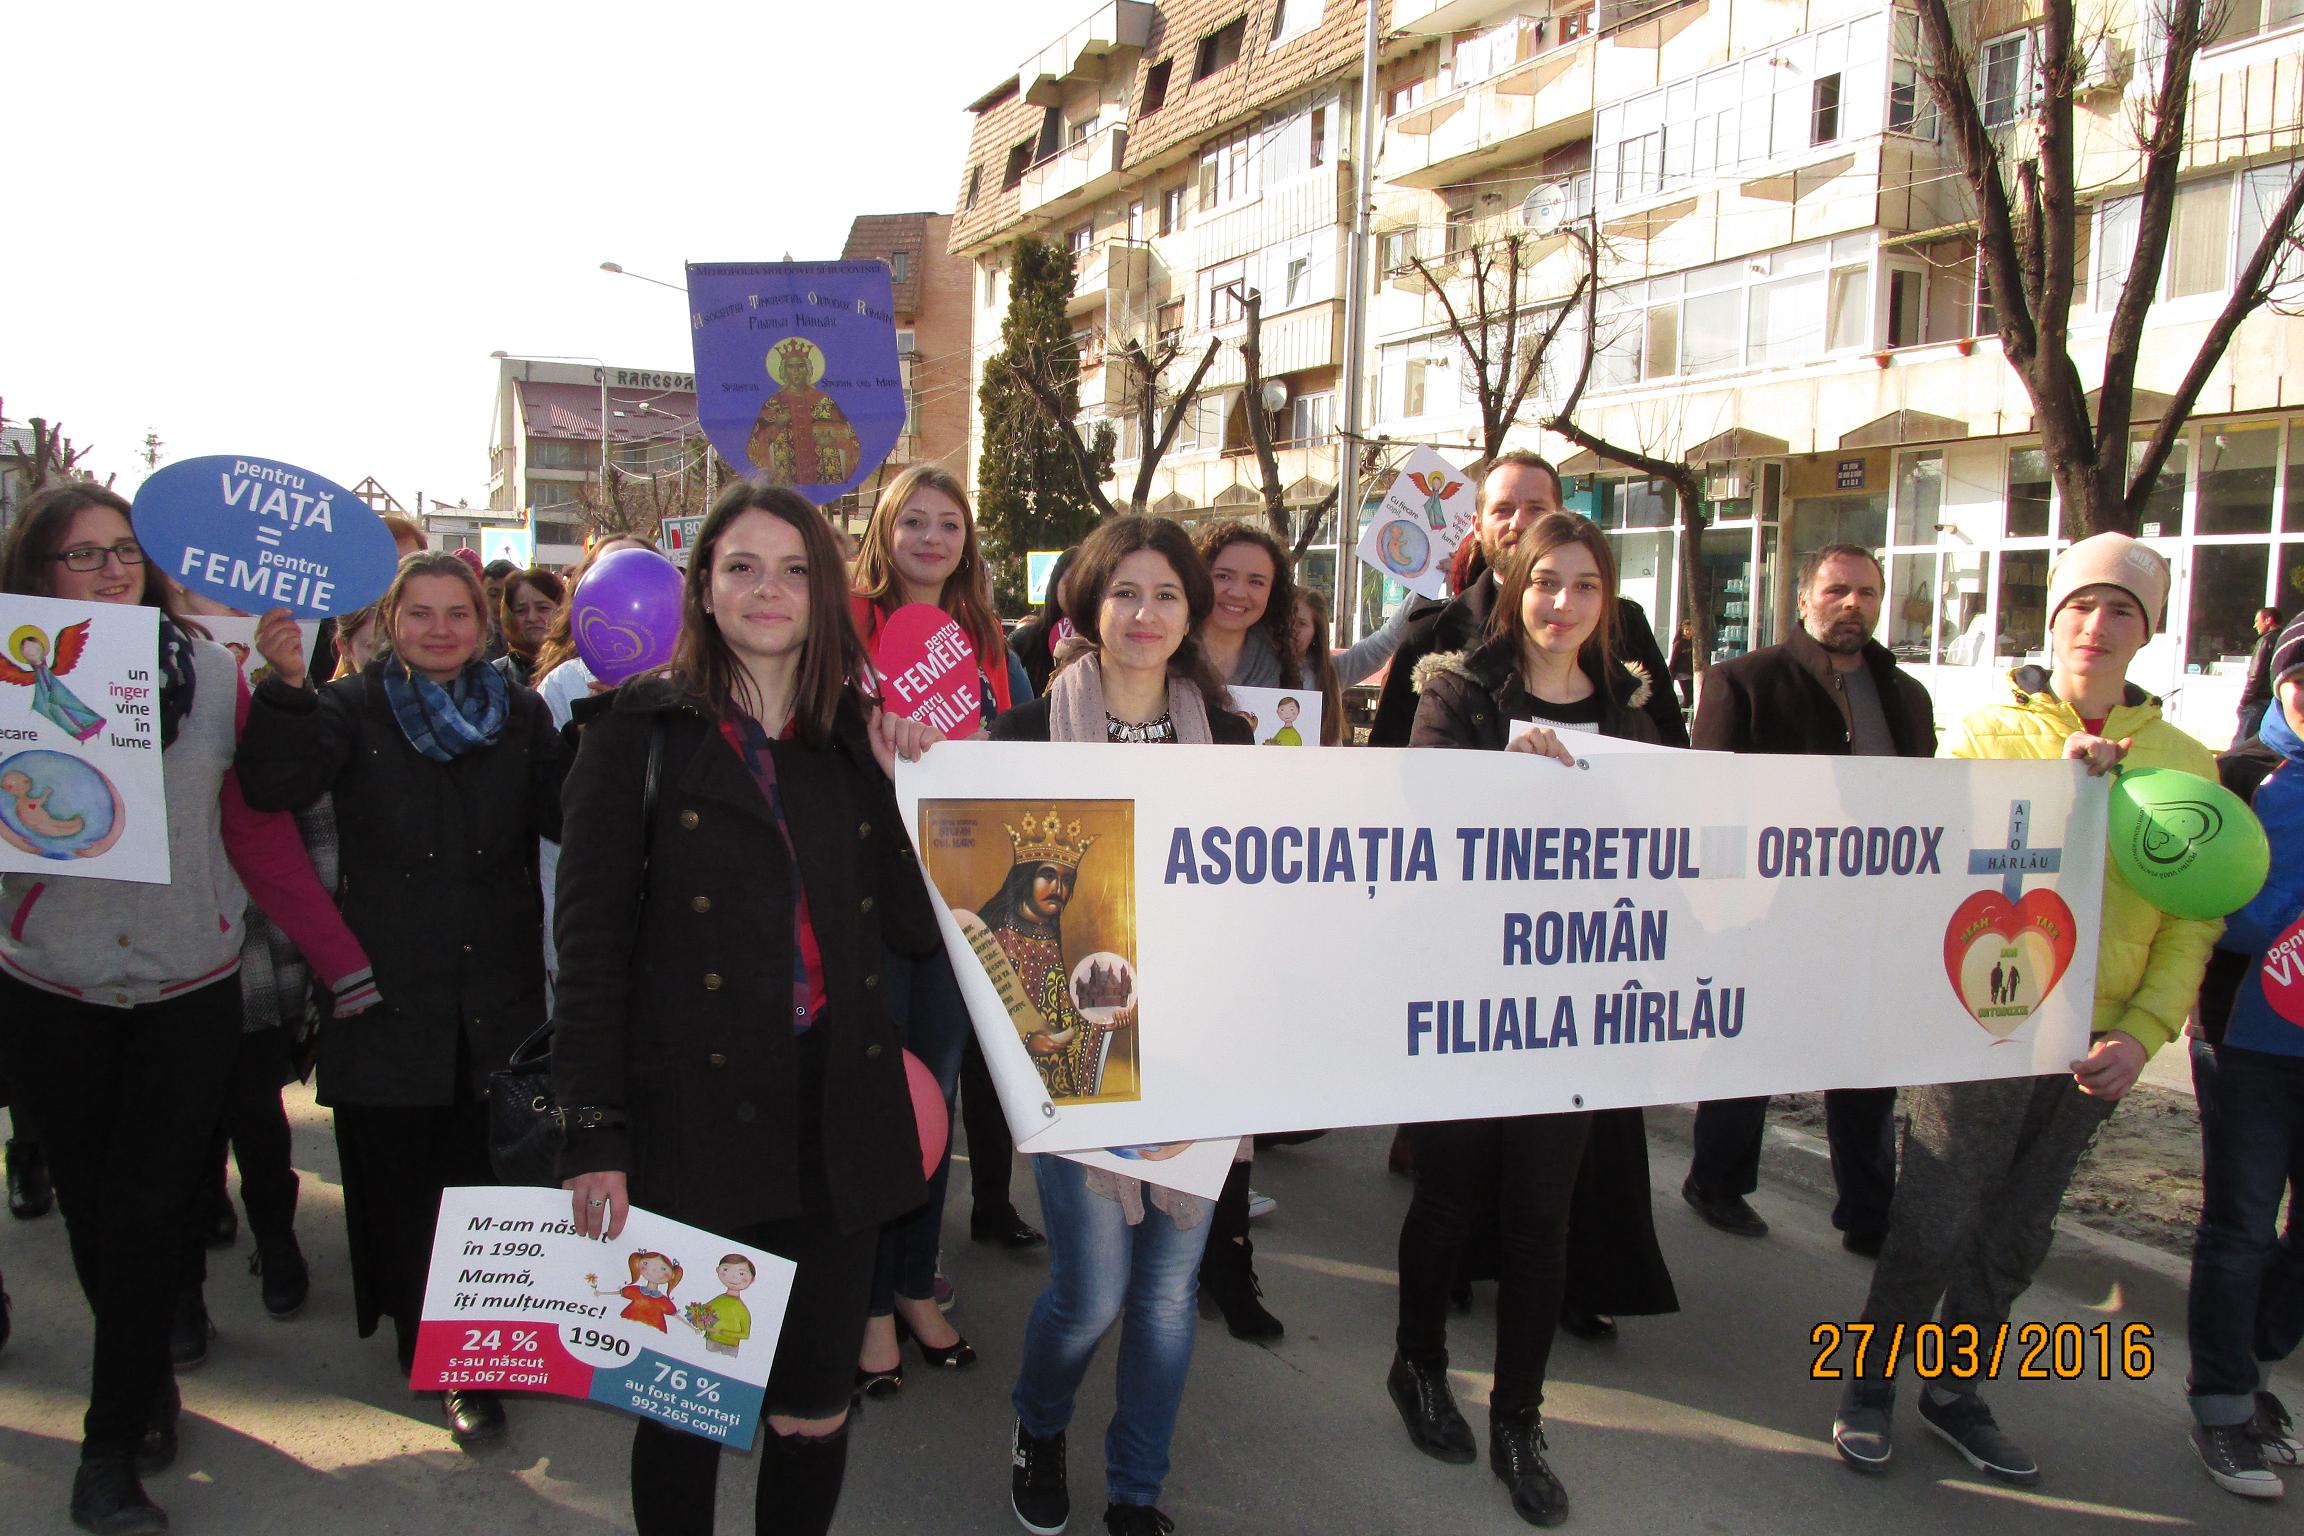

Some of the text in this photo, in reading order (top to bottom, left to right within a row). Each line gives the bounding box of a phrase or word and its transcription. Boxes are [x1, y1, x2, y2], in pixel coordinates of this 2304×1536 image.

[233, 459, 306, 491] pentru
[222, 472, 335, 533] VIAȚĂ
[1390, 495, 1400, 506] Cu
[259, 549, 330, 579] pentru
[180, 546, 336, 613] FEMEIE
[924, 619, 961, 654] pentru
[128, 669, 149, 682] un
[892, 631, 973, 703] FEMEIE
[108, 681, 150, 701] înger
[115, 701, 151, 716] vine
[928, 684, 981, 734] MILIE
[133, 718, 151, 733] în
[110, 733, 152, 750] lume
[1164, 826, 1944, 899] ASOCIAȚIA TINERETUL ORTODOX
[1502, 896, 1668, 966] ROMÂN
[1407, 976, 1746, 1057] FILIALA HÎRLĂU
[467, 1215, 608, 1244] M-am năst
[462, 1241, 546, 1258] în 1990.
[458, 1267, 535, 1288] Mamă,
[453, 1292, 608, 1320] îți mulțumesc!
[462, 1328, 539, 1352] 24 %
[568, 1325, 631, 1358] 1990
[449, 1354, 545, 1369] s-au născut
[439, 1370, 549, 1386] 315.067 copii
[653, 1361, 721, 1404] 76 %
[624, 1381, 741, 1427] au fost avortați
[631, 1394, 728, 1438] 992.265 copii
